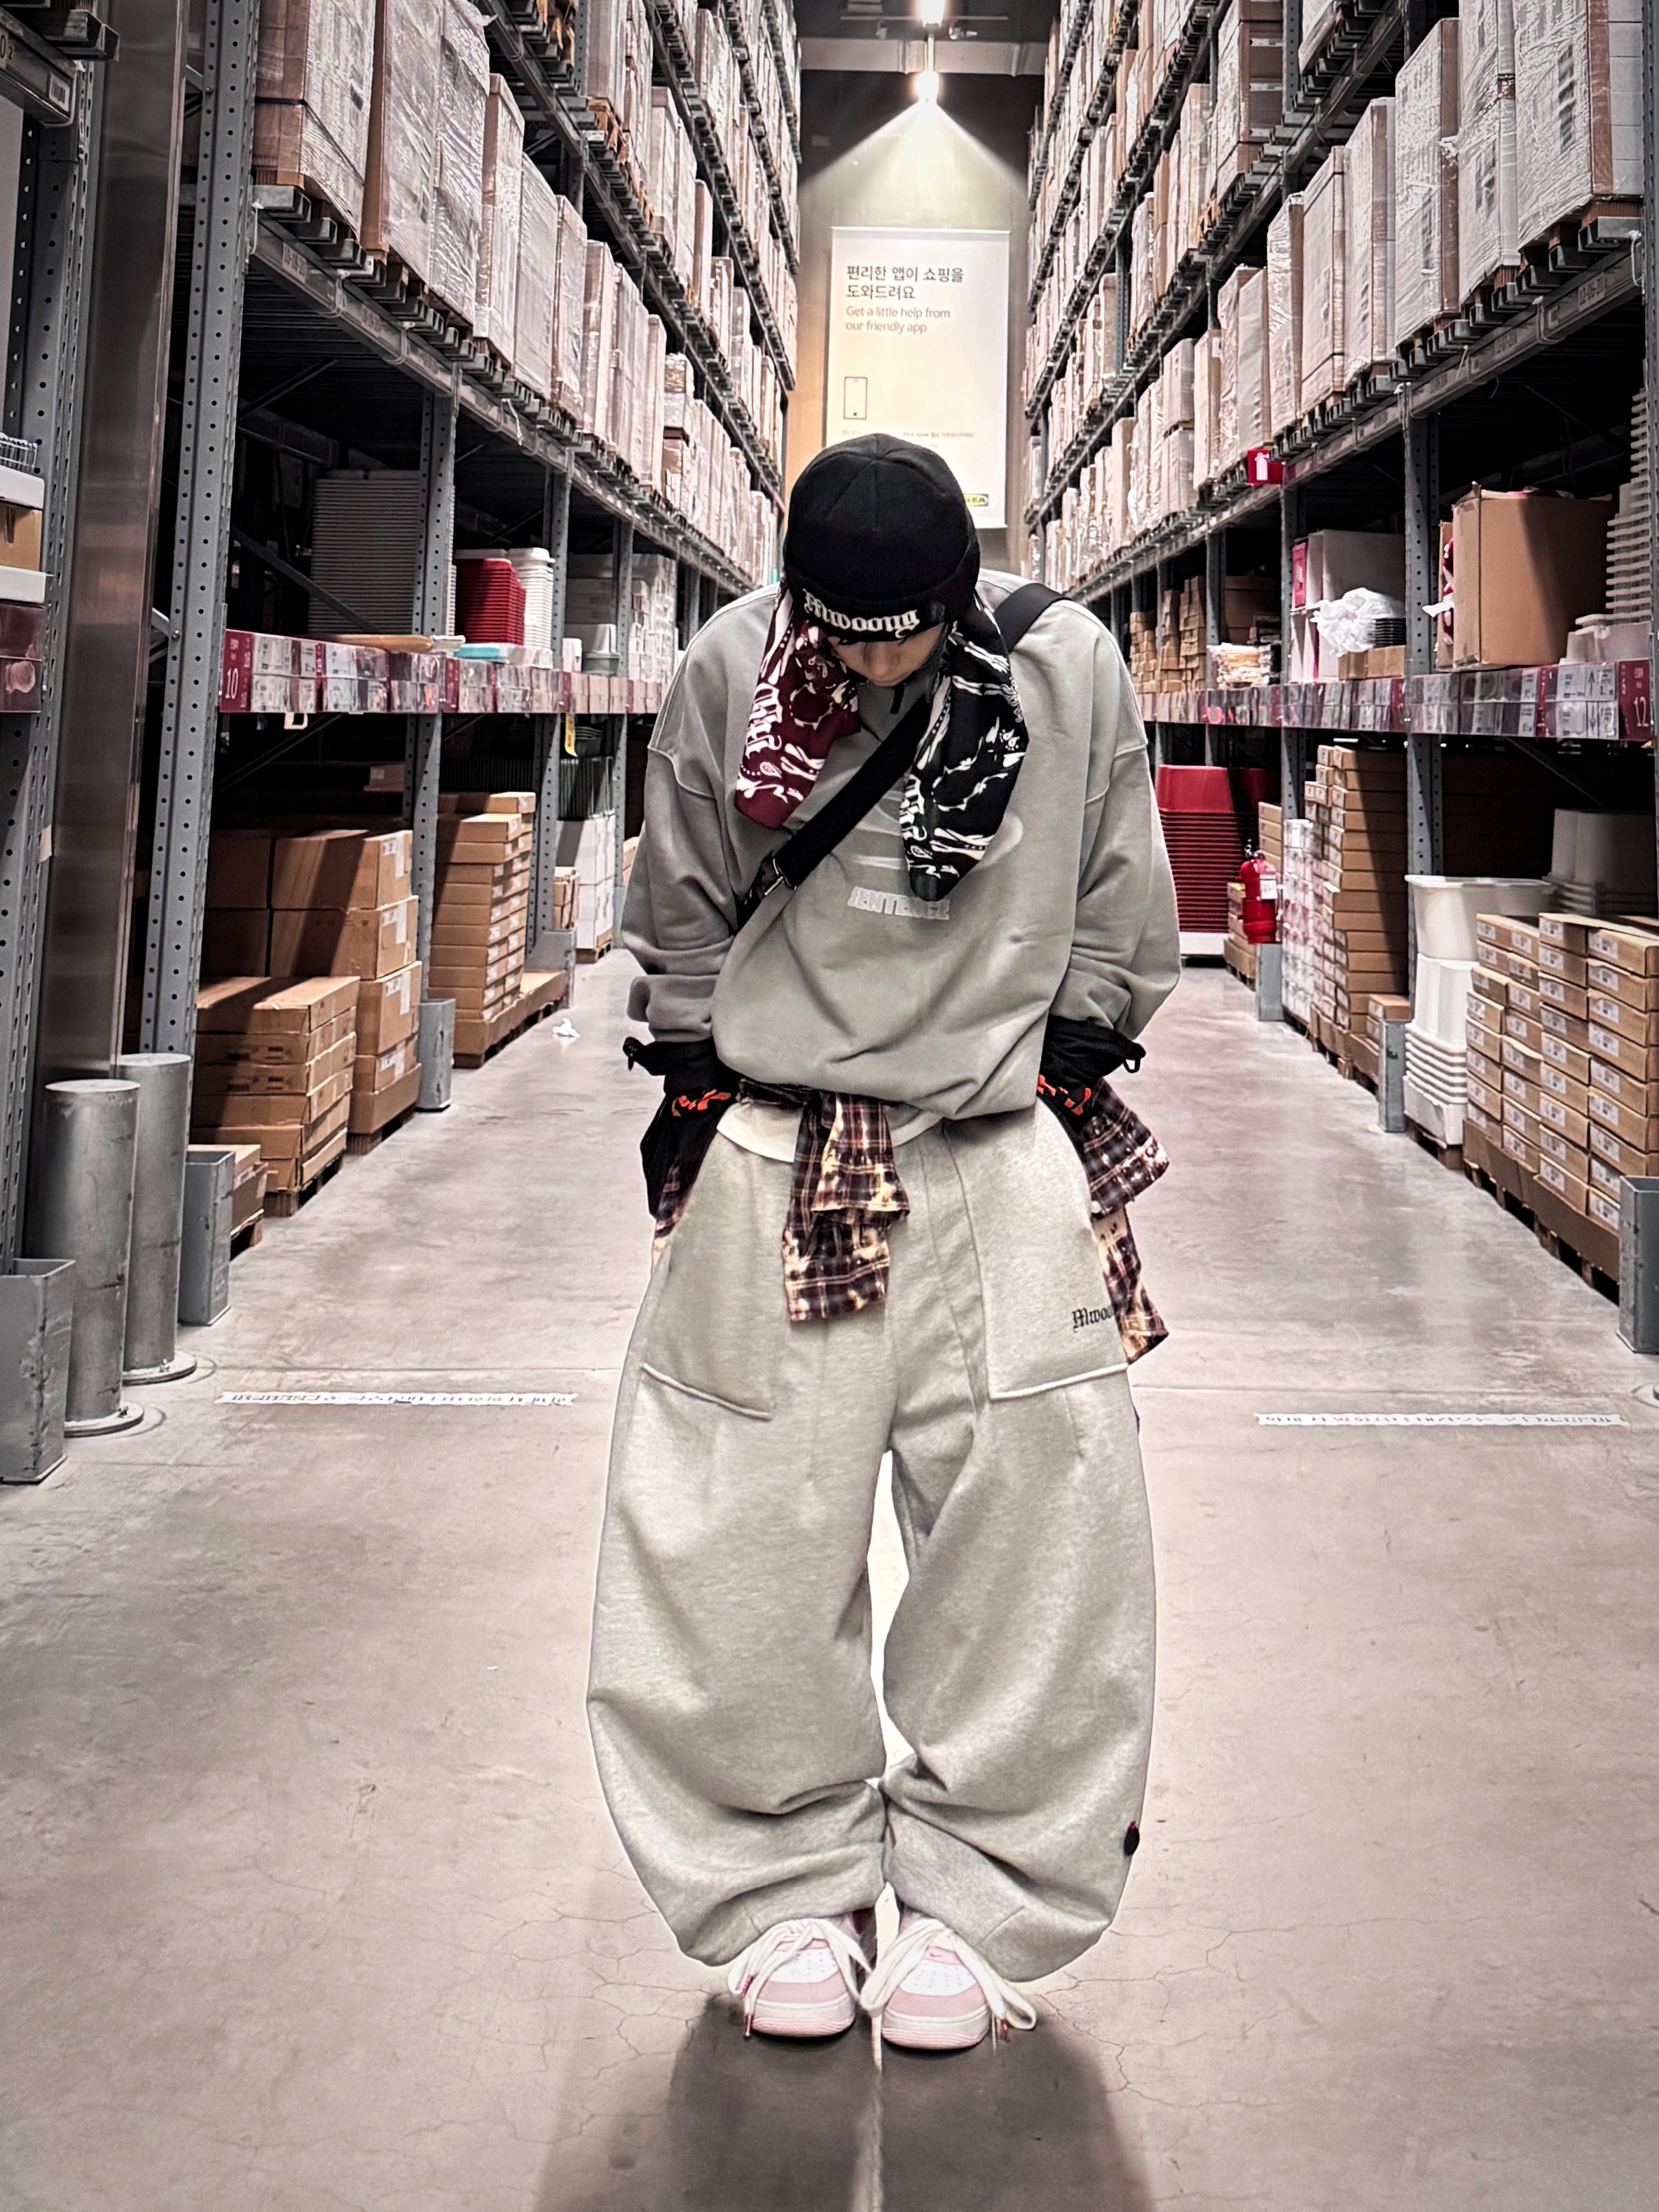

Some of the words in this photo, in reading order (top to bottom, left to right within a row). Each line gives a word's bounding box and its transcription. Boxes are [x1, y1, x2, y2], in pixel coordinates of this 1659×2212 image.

[846, 265, 887, 280] 편리한
[892, 266, 918, 282] 앱이
[923, 267, 964, 283] 쇼핑을
[846, 284, 916, 300] 도와드려요
[846, 305, 865, 317] Get
[867, 308, 874, 317] a
[876, 306, 898, 317] little
[900, 307, 923, 320] help
[925, 308, 951, 318] from
[846, 321, 864, 331] our
[866, 320, 904, 334] friendly
[907, 324, 928, 335] app
[225, 668, 239, 699] 10
[1634, 696, 1649, 727] 12
